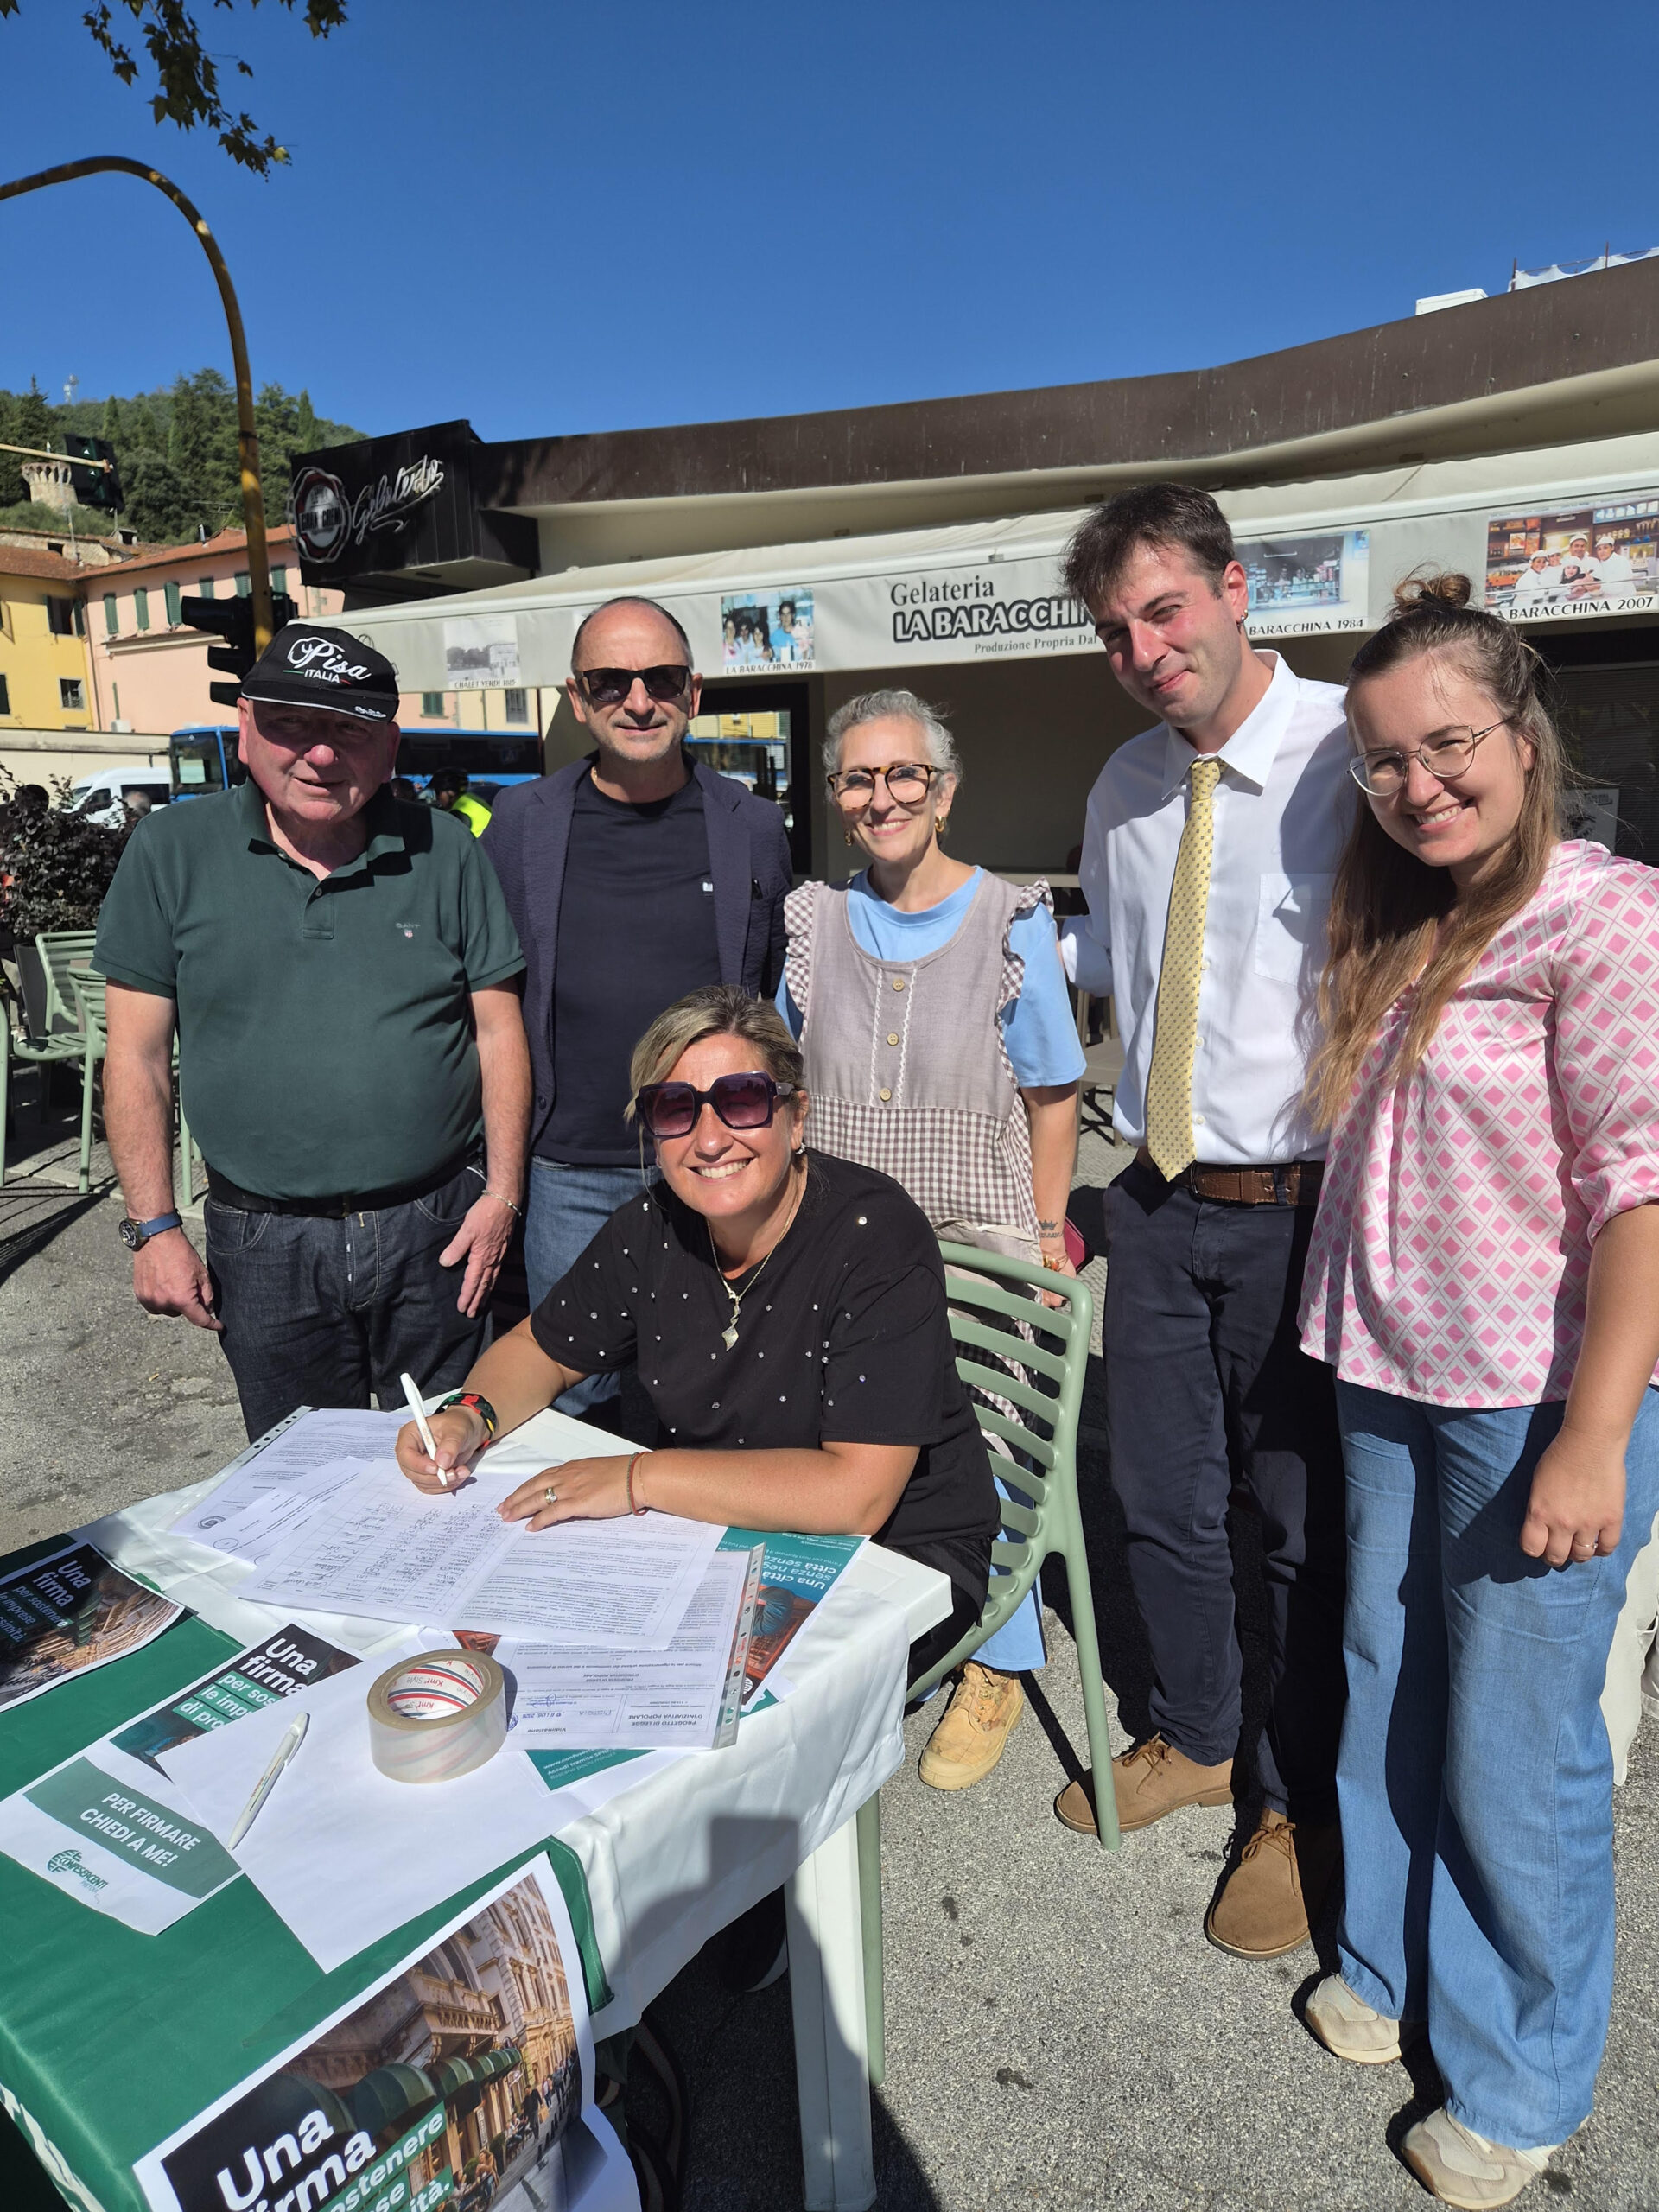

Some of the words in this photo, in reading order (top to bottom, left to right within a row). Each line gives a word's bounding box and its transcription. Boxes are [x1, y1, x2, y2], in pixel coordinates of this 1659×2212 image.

[890, 575, 995, 607] Gelateria
[893, 607, 931, 644] LA
[931, 595, 1097, 641] BARACCHI
[1509, 600, 1611, 620] BARACCHINA
[1617, 596, 1655, 611] 2007
[1249, 621, 1332, 636] BARACCHINA
[1338, 619, 1363, 630] 1984
[287, 636, 372, 680] Pisa
[974, 641, 1032, 654] Produzione
[1033, 637, 1075, 651] Propria
[304, 669, 340, 683] ITALIA
[726, 665, 737, 675] LA
[739, 663, 792, 673] BARACCHINA
[57, 1560, 92, 1589] Una
[762, 1571, 794, 1583] città
[763, 1561, 788, 1573] neg
[791, 1568, 832, 1581] senza
[804, 1562, 837, 1574] città
[32, 1571, 74, 1608] firma
[797, 1577, 826, 1590] Una
[2, 1598, 36, 1624] imprese
[12, 1586, 35, 1599] per
[28, 1596, 68, 1627] sostenere
[265, 1637, 318, 1676] Una
[218, 1674, 251, 1693] per
[238, 1655, 308, 1697] firma
[200, 1685, 219, 1700] le
[180, 1701, 203, 1717] di
[101, 1792, 137, 1815] PER
[129, 1807, 201, 1851] FIRMARE
[79, 1808, 136, 1843] CHIEDI
[126, 1837, 147, 1852] A
[140, 1844, 179, 1867] ME!
[216, 2109, 334, 2212] Una
[330, 2112, 444, 2212] ostenere
